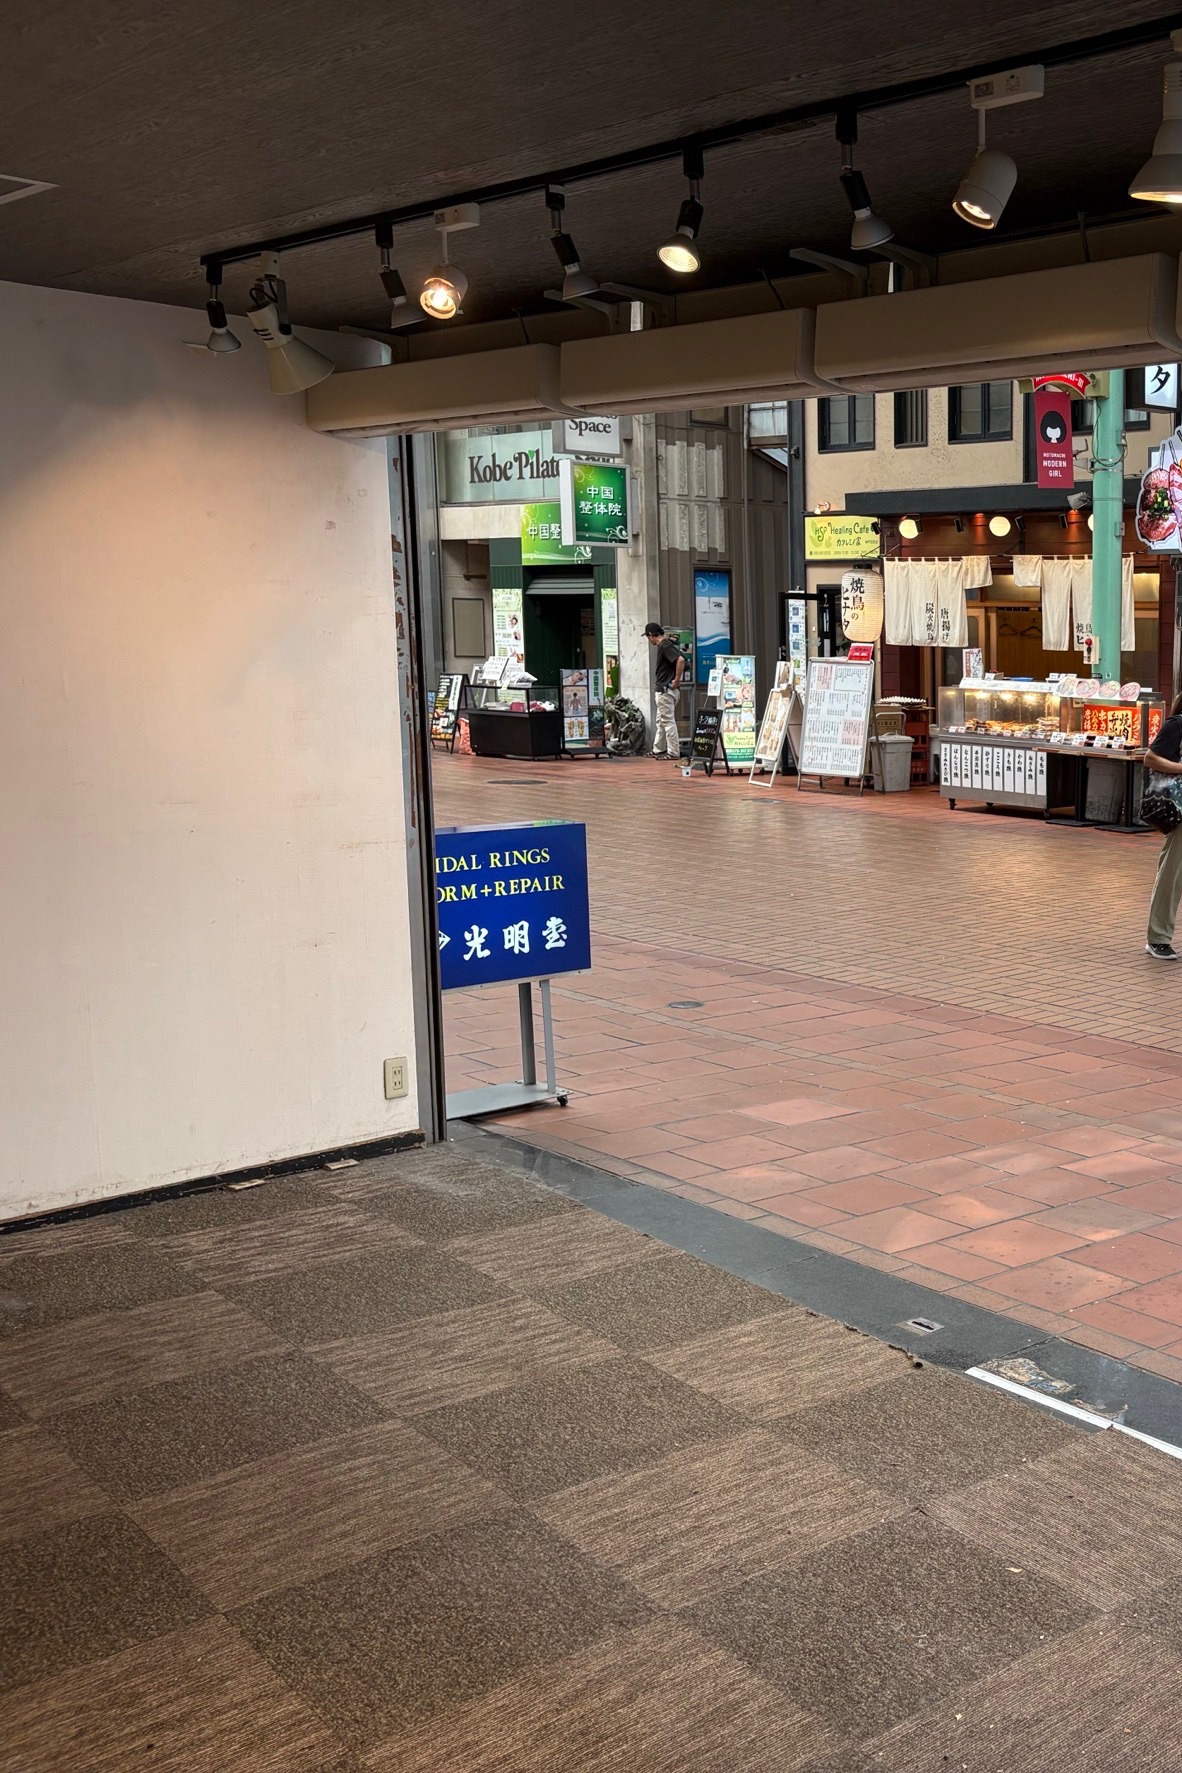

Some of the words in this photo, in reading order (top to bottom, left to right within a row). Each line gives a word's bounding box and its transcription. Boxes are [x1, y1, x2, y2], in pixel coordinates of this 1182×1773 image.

[569, 419, 612, 437] Space
[468, 453, 513, 484] Kobe
[1042, 460, 1067, 468] MODERN
[1048, 470, 1063, 478] GIRL
[586, 485, 614, 500] 中国
[578, 501, 622, 516] 整体院
[827, 522, 853, 536] Healing
[853, 522, 870, 534] Cafe
[850, 577, 865, 621] 焼鳥の
[941, 607, 950, 640] 唐揚げ
[489, 848, 551, 869] RINGS
[463, 916, 568, 961] 光明堂
